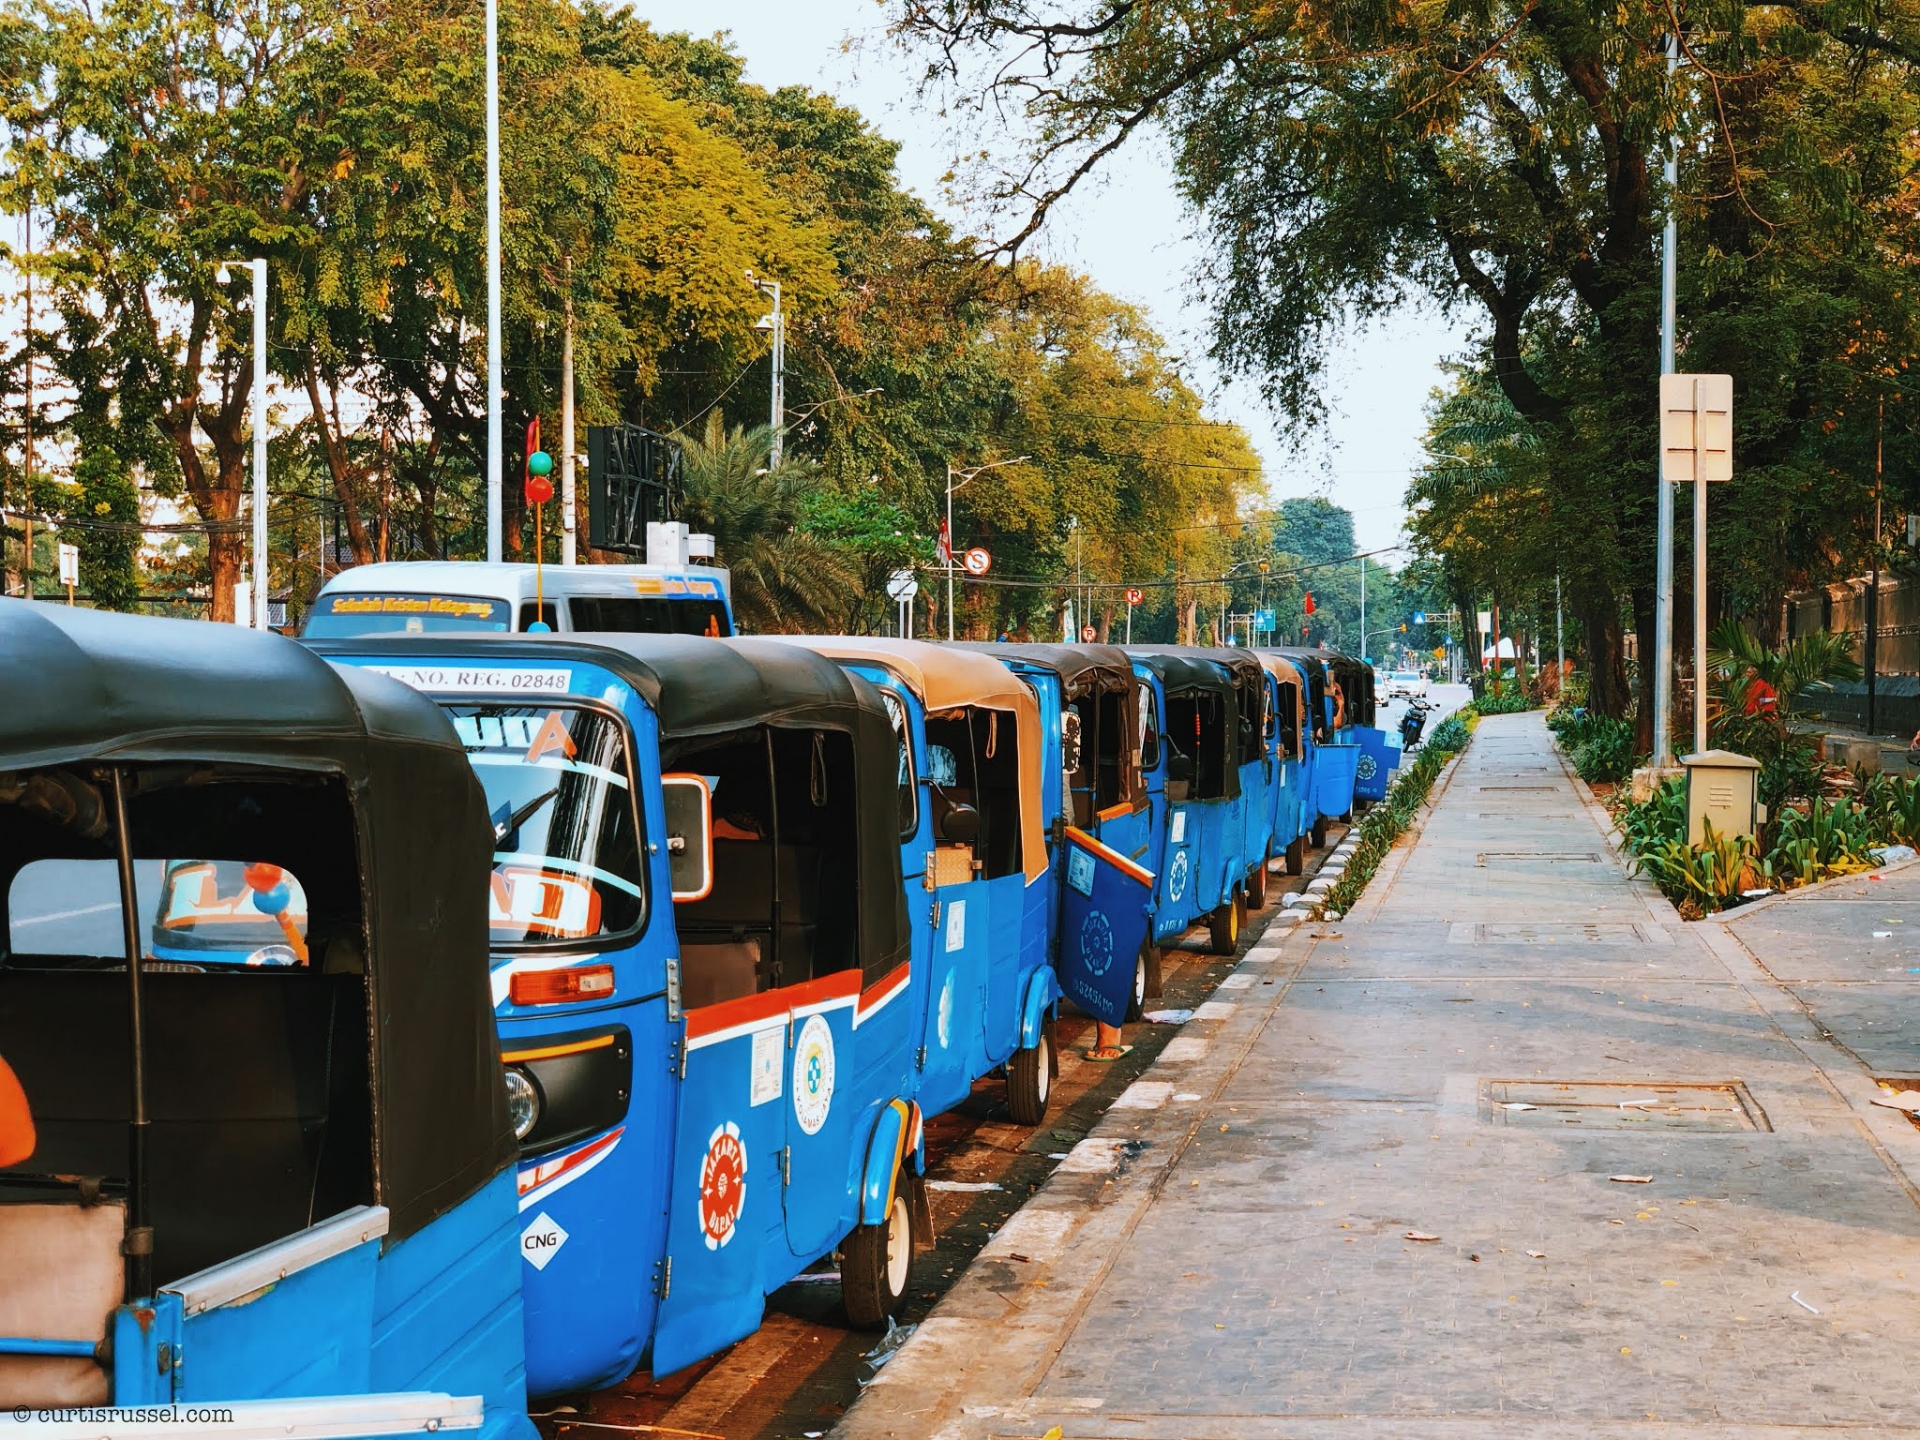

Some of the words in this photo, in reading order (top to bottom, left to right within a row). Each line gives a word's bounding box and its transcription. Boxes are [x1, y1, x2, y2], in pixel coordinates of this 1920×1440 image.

[412, 671, 449, 685] NO.
[457, 673, 506, 686] REG.
[511, 674, 565, 689] 02848
[706, 1138, 740, 1182] JAKARTA
[708, 1204, 734, 1235] BARAT
[524, 1232, 557, 1250] CNG
